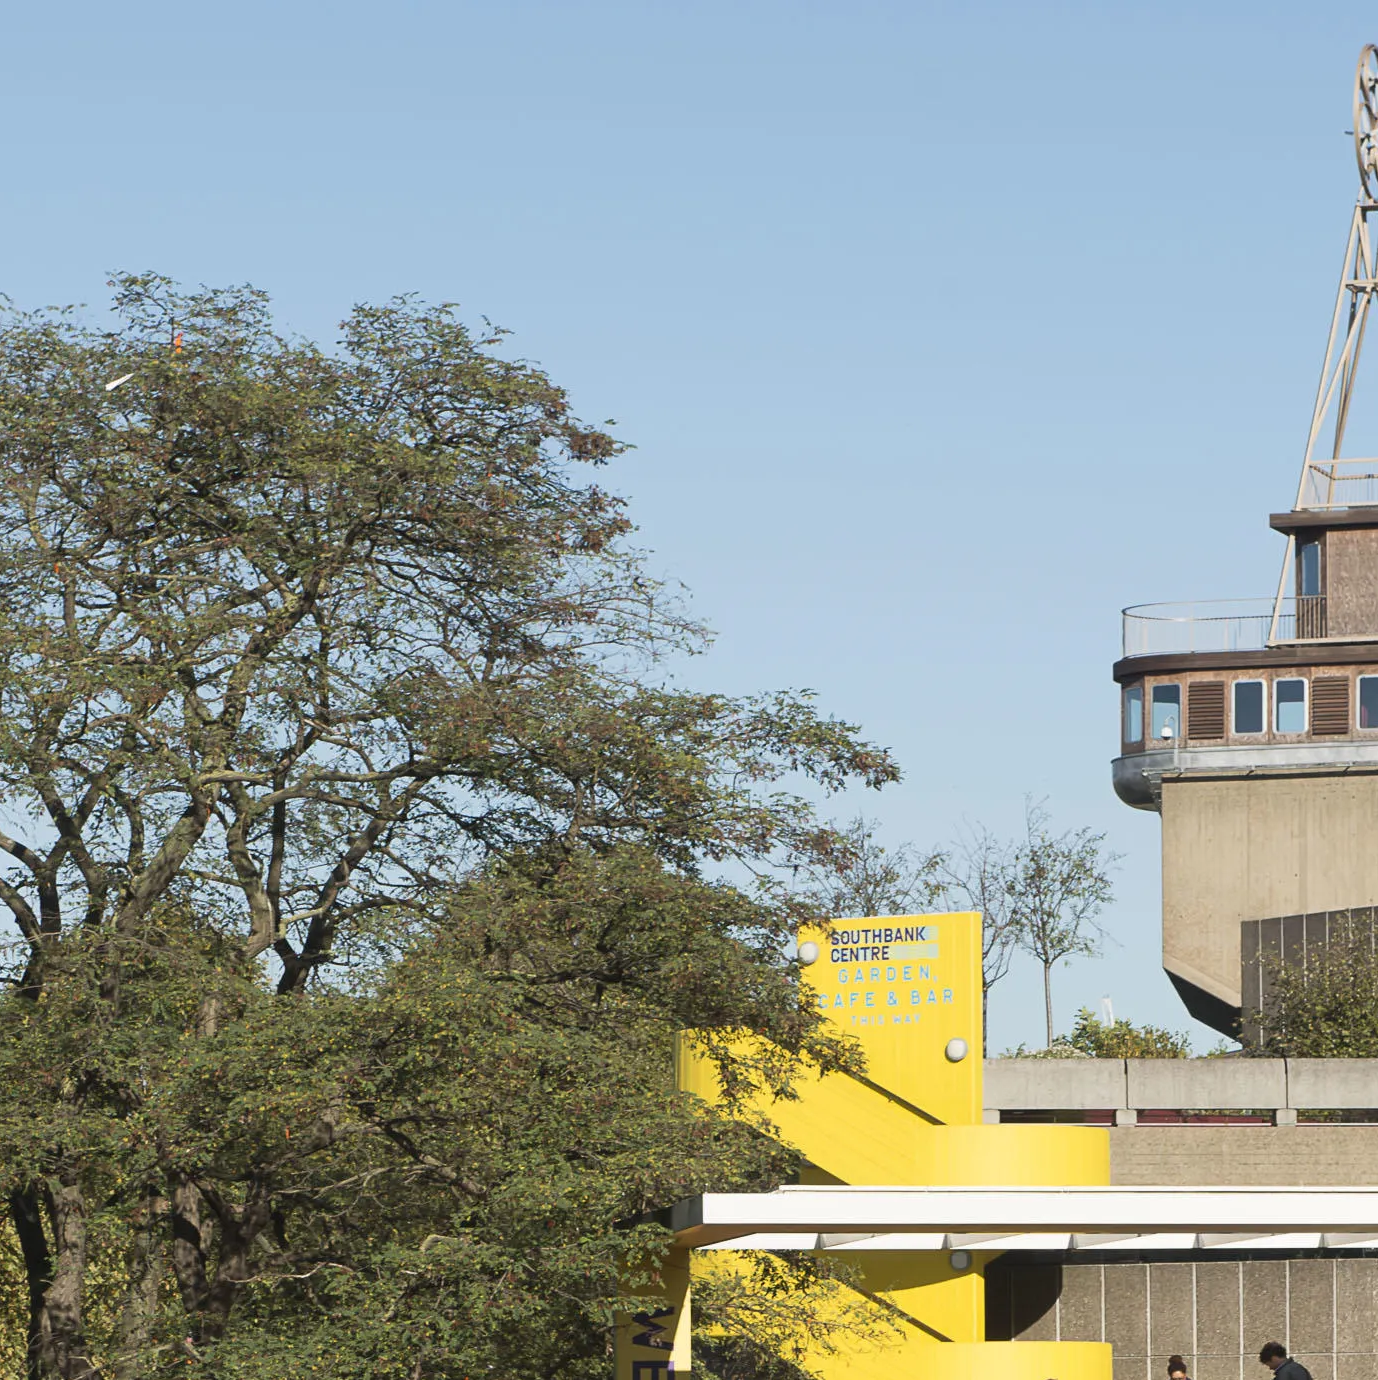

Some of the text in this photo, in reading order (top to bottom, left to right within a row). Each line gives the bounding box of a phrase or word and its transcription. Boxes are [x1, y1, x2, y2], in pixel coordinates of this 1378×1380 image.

[830, 926, 926, 946] SOUTHBANK
[831, 946, 890, 962] CENTRE
[838, 965, 938, 984] GARDEN,
[819, 988, 953, 1009] CAFE & BAR
[851, 1014, 921, 1026] THIS WAY
